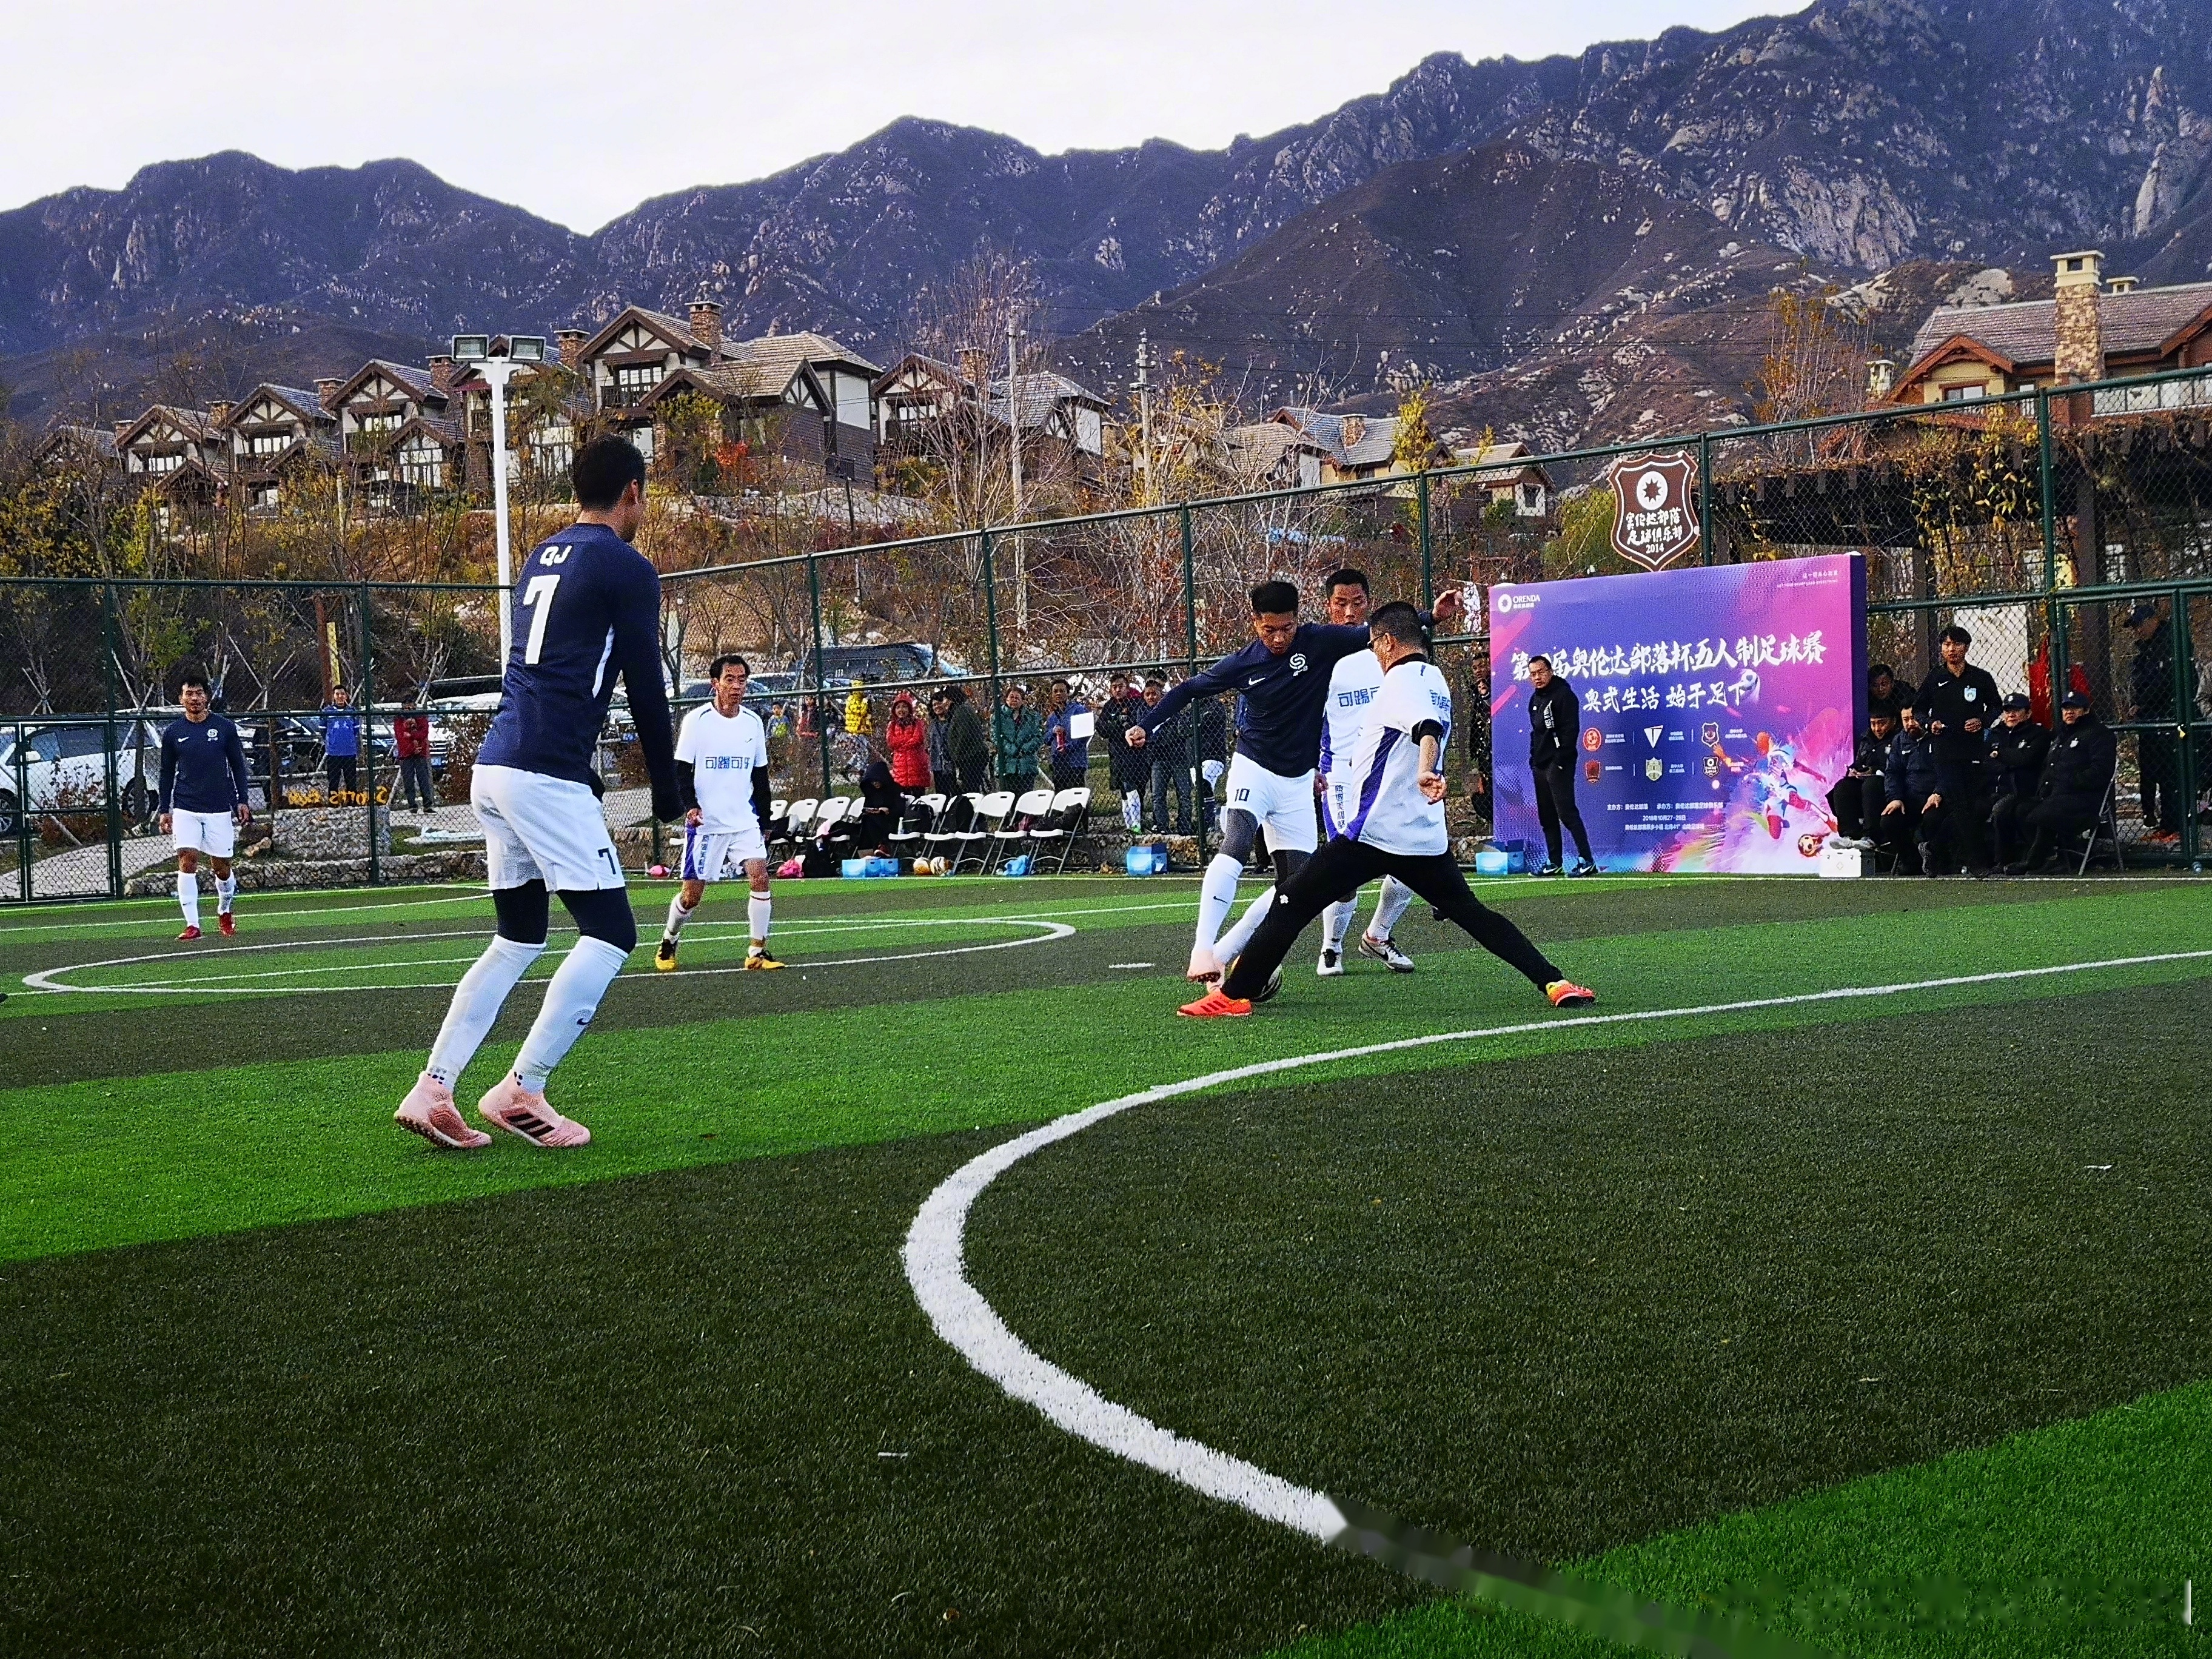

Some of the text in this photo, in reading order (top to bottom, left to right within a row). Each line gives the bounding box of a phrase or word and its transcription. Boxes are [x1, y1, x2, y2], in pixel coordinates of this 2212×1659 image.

[540, 545, 572, 566] QJ
[1645, 543, 1664, 554] 2014
[1512, 594, 1541, 603] ORENDA
[523, 574, 561, 665] 7
[1511, 630, 1827, 680] 第届奥伦达部落杯五人制足球赛
[1583, 682, 1745, 713] 奥式生活 始于足下
[1235, 788, 1250, 802] 10
[598, 848, 617, 874] 7
